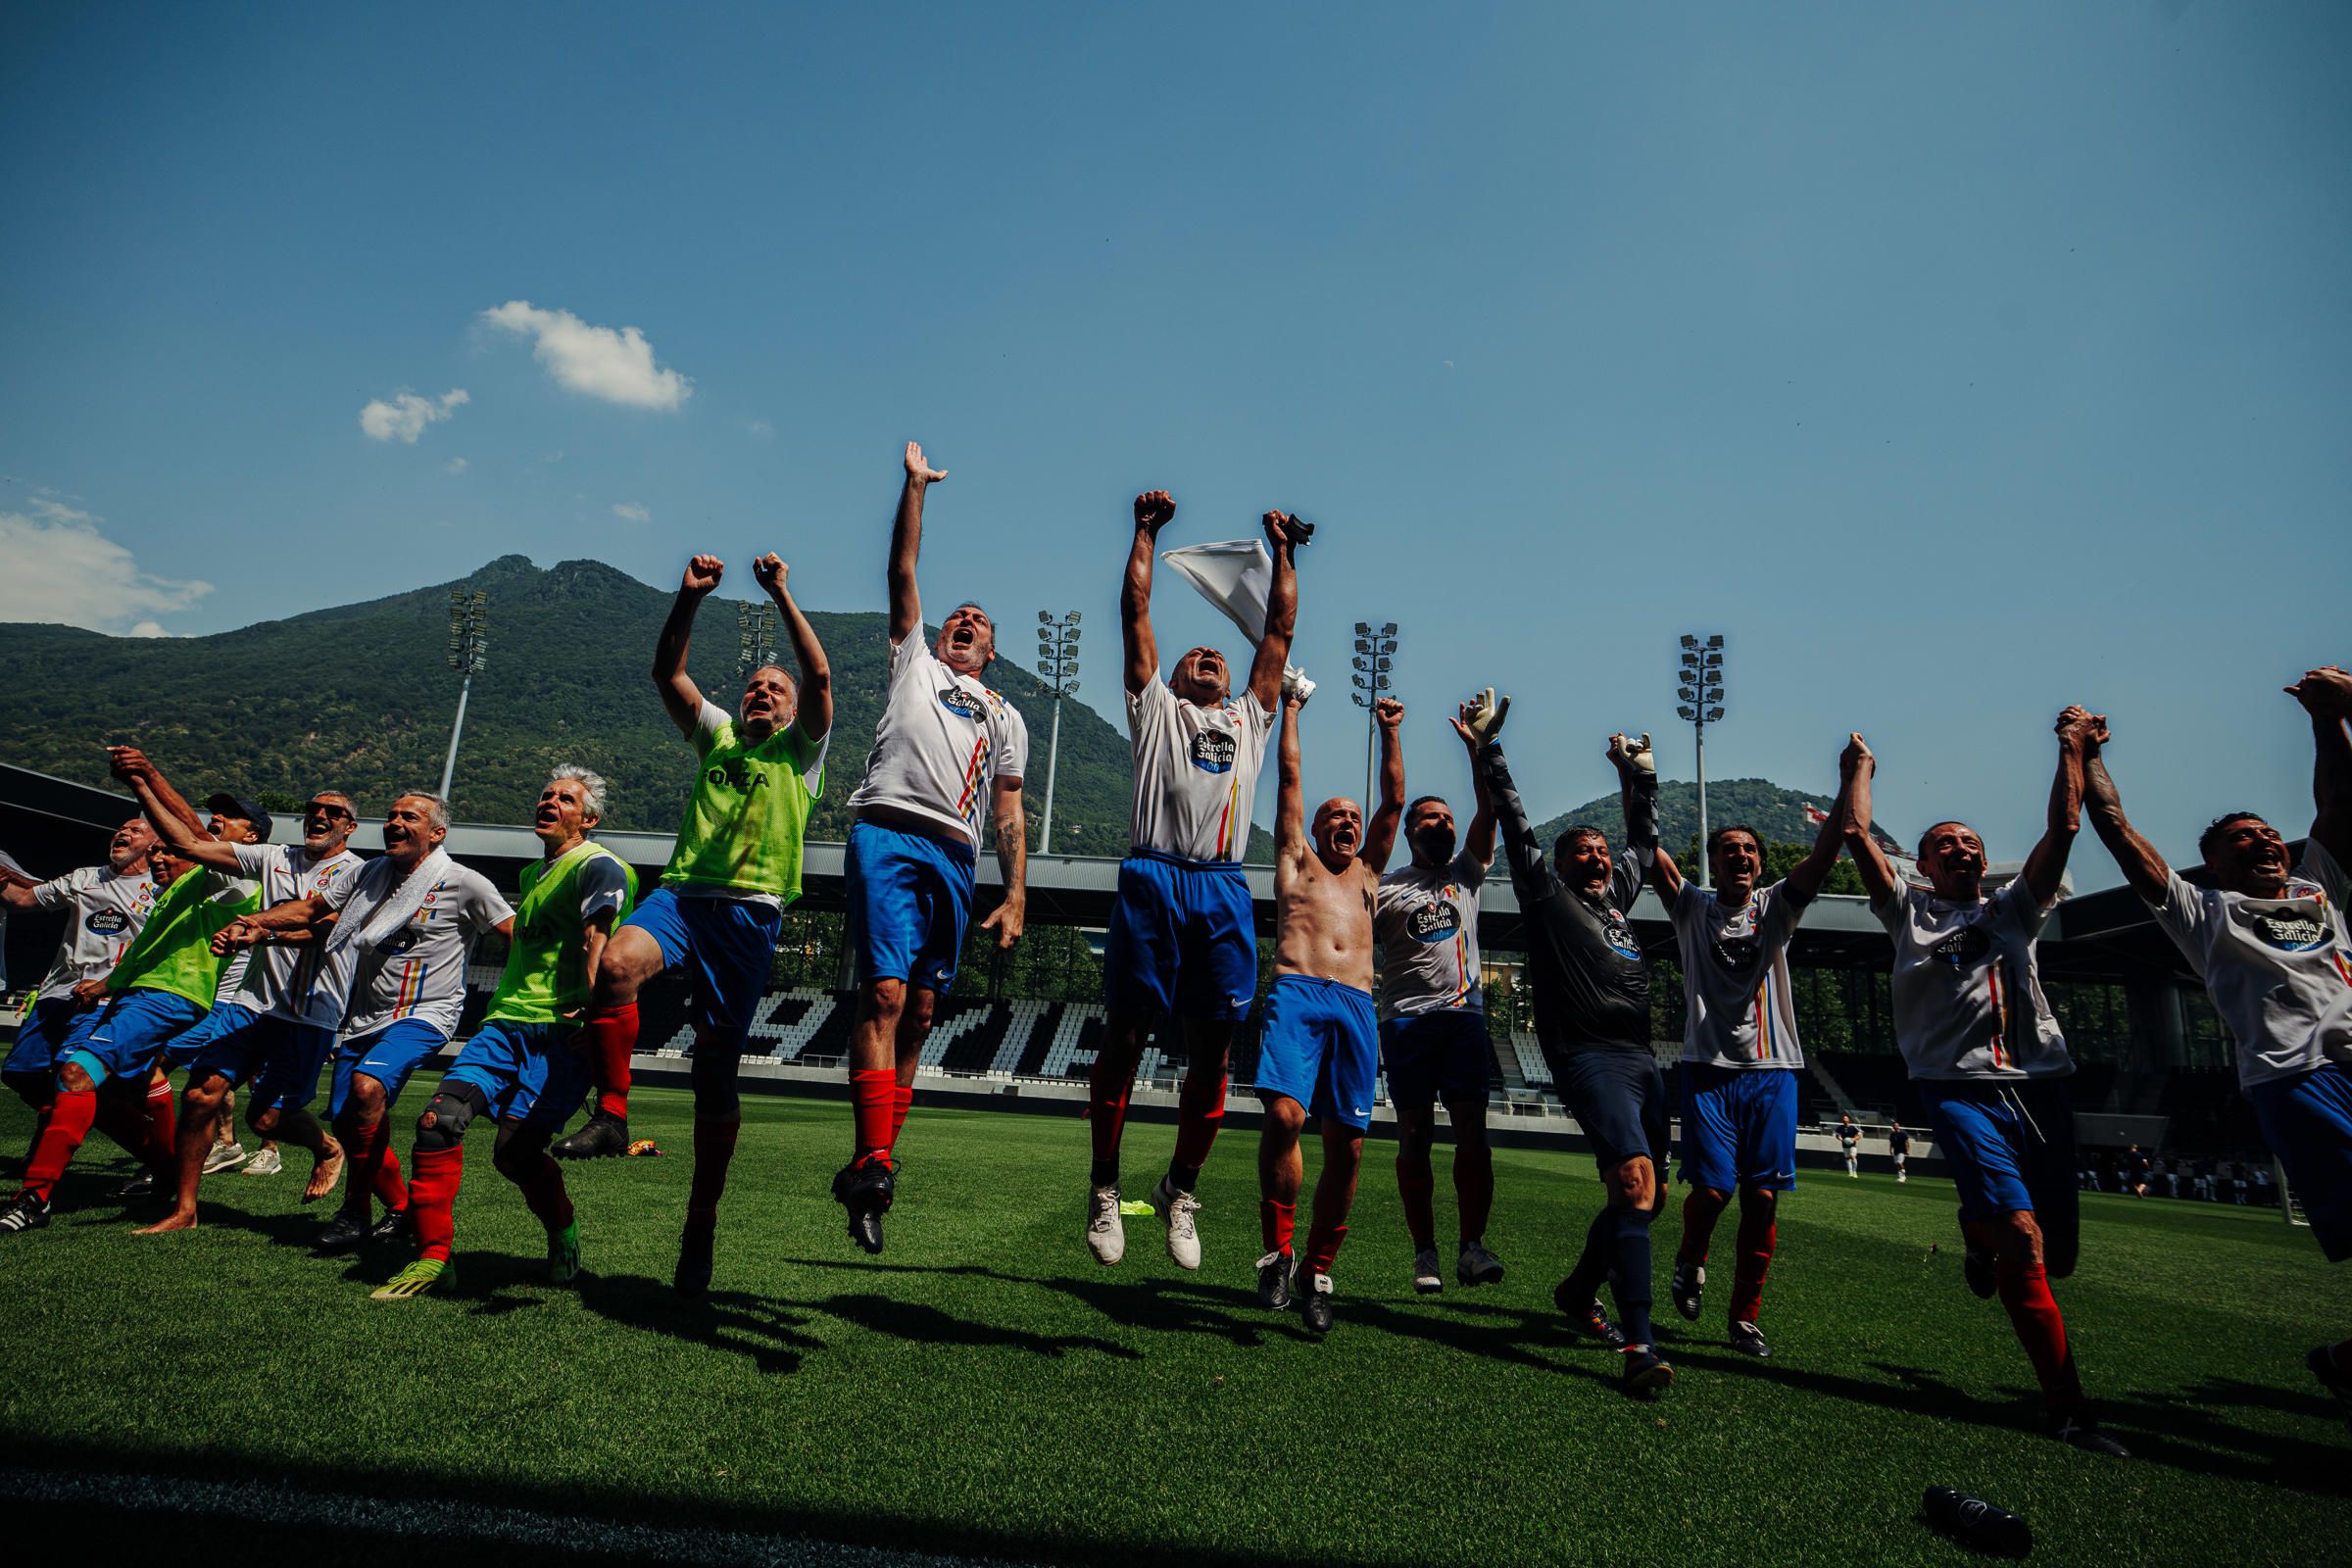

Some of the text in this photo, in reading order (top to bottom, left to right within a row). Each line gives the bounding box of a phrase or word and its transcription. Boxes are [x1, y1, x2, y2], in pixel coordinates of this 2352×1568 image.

[93, 920, 119, 930] Galicia
[94, 913, 122, 923] Estrella
[2266, 918, 2317, 932] Estrella
[1418, 918, 1452, 934] Galicia
[2272, 928, 2321, 942] Galicia
